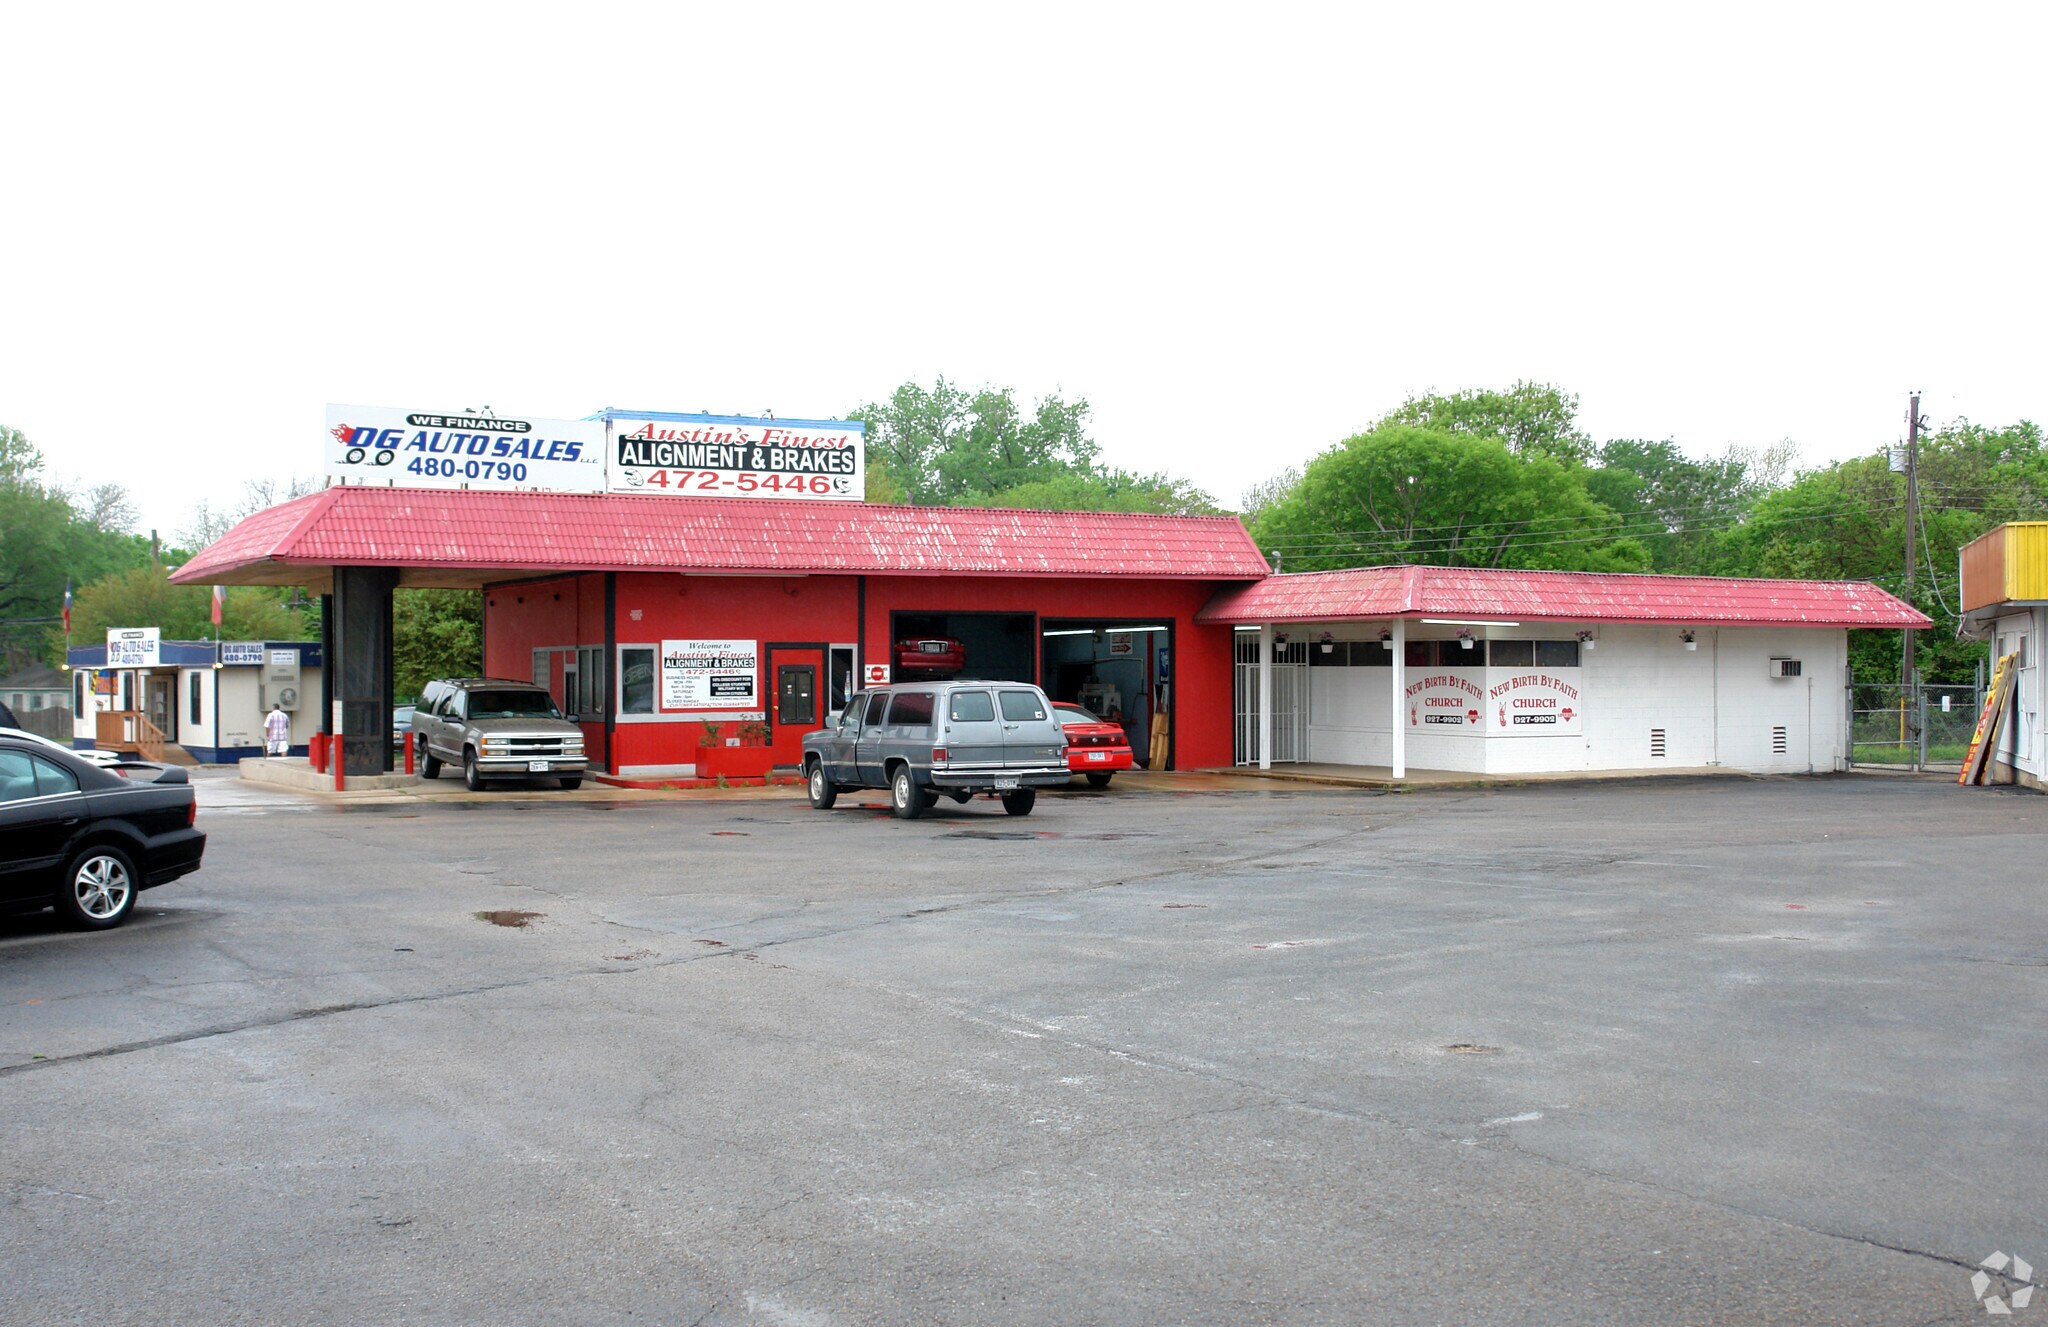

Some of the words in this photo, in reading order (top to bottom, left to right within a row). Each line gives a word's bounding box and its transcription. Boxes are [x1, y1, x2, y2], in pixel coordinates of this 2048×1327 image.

[412, 415, 445, 427] WE
[446, 417, 527, 432] FINANCE
[625, 423, 750, 446] Austin's
[755, 428, 849, 450] Finest
[347, 426, 405, 450] DG
[404, 430, 491, 456] AUTO
[491, 436, 584, 462] SALES
[621, 442, 748, 469] ALIGNMENT
[751, 447, 766, 470] &
[770, 448, 855, 473] BRAKES
[407, 457, 527, 482] 480-0790
[647, 469, 831, 494] 472-5446
[122, 641, 137, 652] AUTO
[137, 640, 154, 652] SALES
[224, 645, 232, 654] DG
[233, 645, 246, 653] AUTO
[247, 645, 263, 653] SALES
[689, 642, 723, 650] Welcome
[224, 654, 263, 662] 480-0790
[668, 650, 714, 658] Austin's
[718, 650, 752, 658] Finest
[665, 659, 712, 668] ALIGNMENT
[714, 659, 720, 668] &
[721, 659, 754, 668] BRAKES
[1406, 682, 1424, 699] NEW
[1425, 675, 1447, 689] BIRTH
[1461, 679, 1484, 701] FAITH
[1489, 681, 1510, 700] NEW
[1512, 675, 1538, 689] BIRTH
[1554, 678, 1578, 701] FAITH
[1425, 697, 1463, 708] CHURCH
[1513, 698, 1557, 709] CHURCH
[1426, 716, 1462, 724] 927-9902
[1514, 715, 1556, 724] 927-9902
